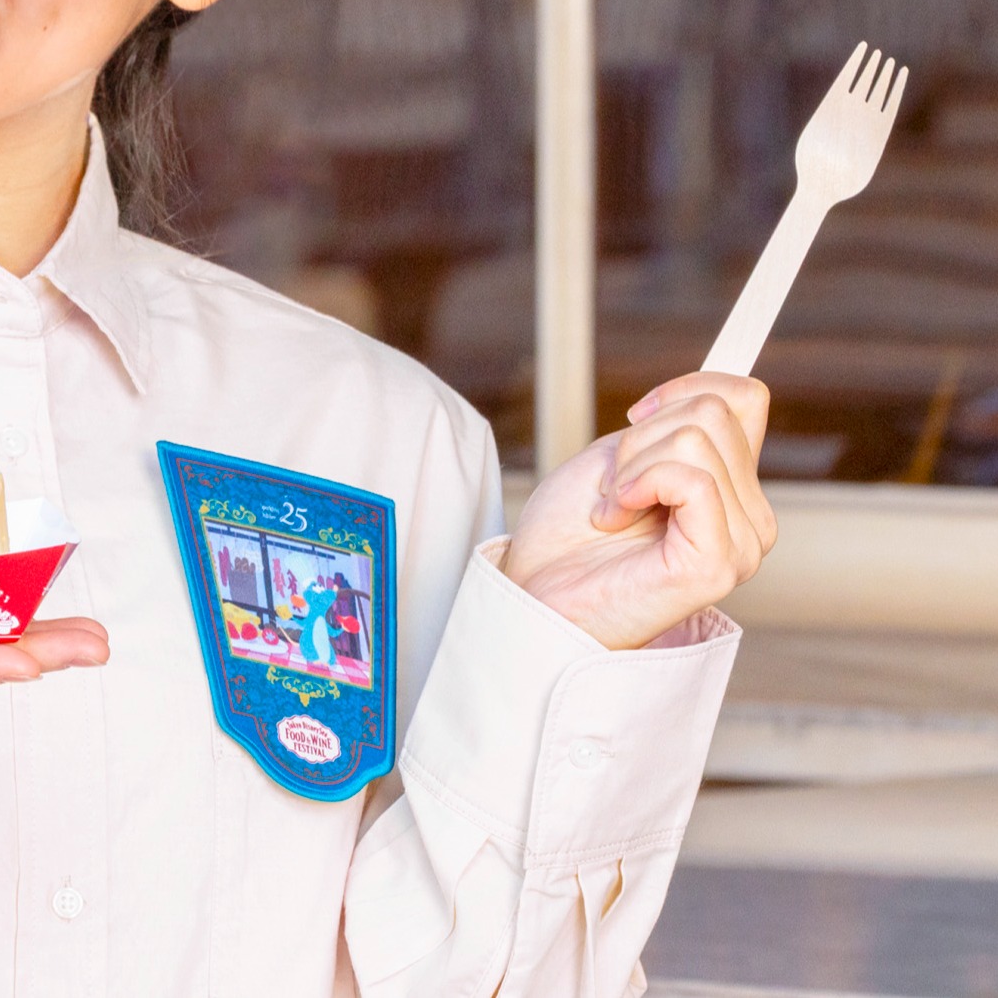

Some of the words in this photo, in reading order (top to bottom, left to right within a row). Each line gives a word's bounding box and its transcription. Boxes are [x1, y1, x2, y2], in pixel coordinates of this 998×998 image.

[279, 501, 308, 533] 25
[285, 728, 306, 743] FOOD
[310, 733, 332, 750] WINE
[293, 742, 326, 758] FESTIVAL
